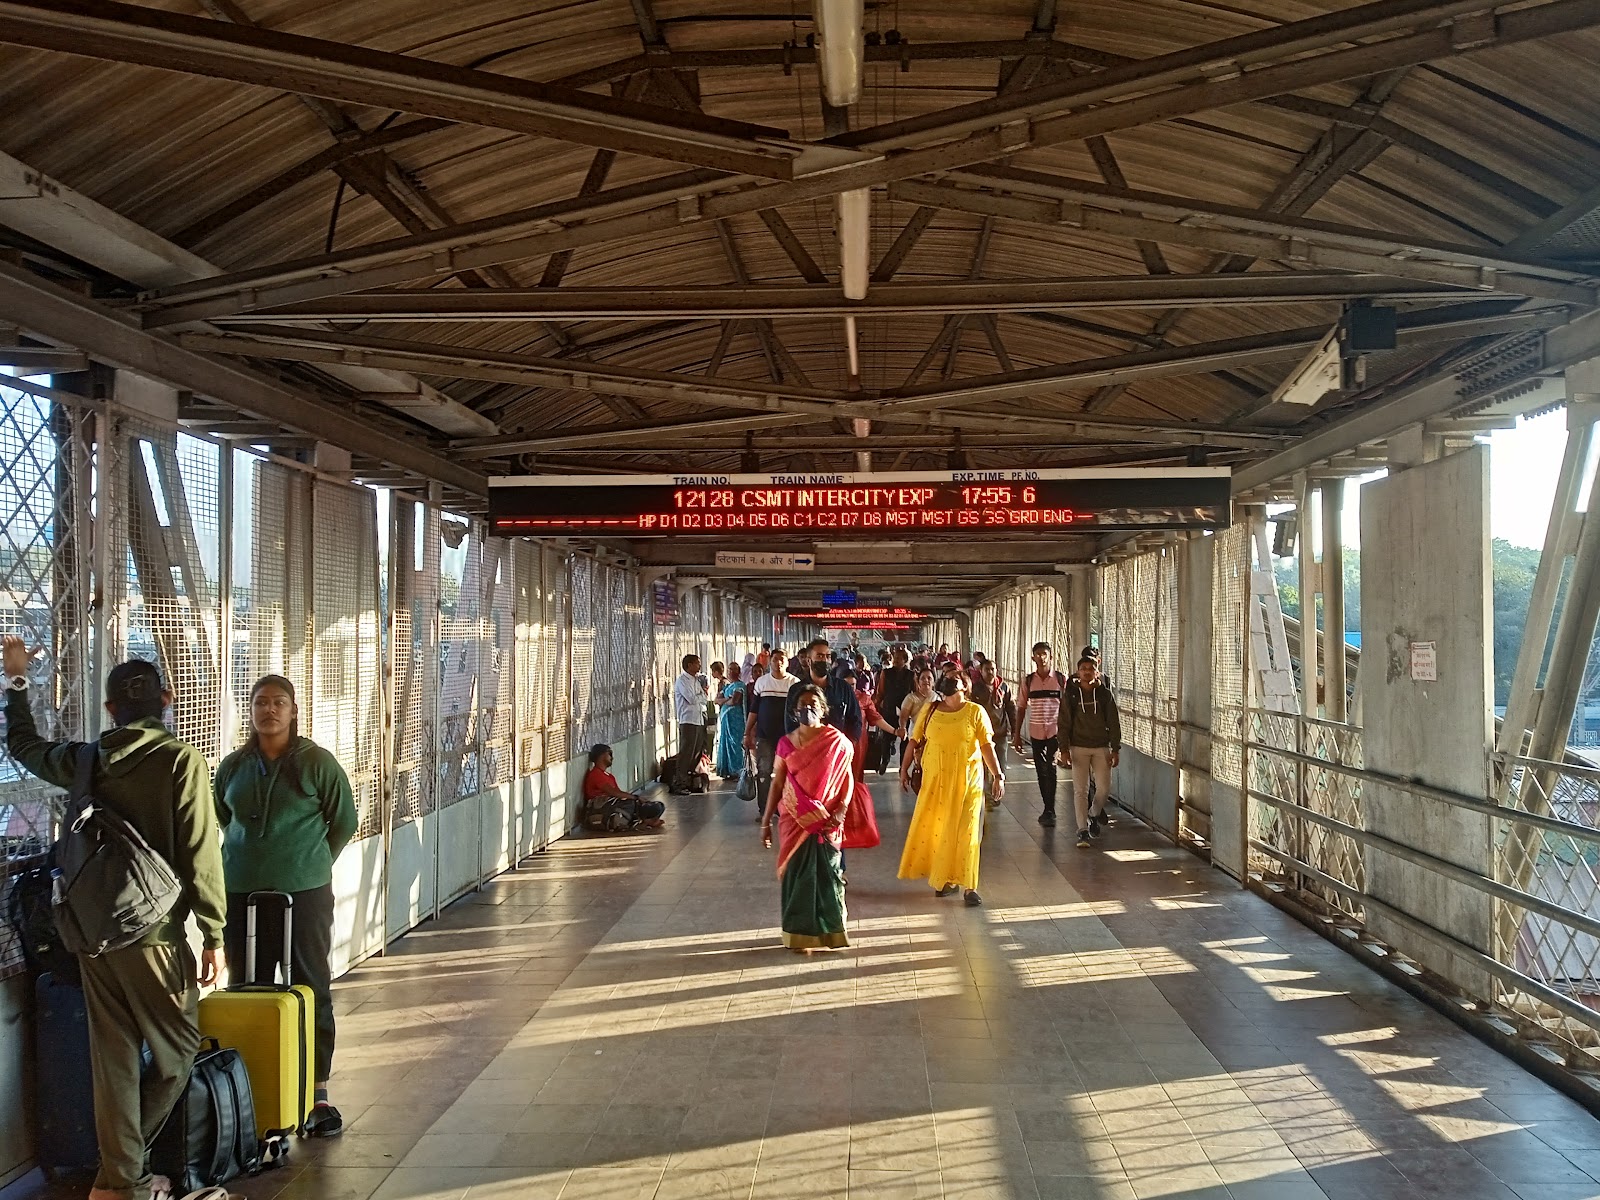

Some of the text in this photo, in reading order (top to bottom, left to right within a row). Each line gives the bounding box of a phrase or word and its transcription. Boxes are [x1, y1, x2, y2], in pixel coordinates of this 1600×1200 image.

[673, 476, 731, 485] TRAIN NO.
[770, 475, 843, 484] TRAIN NAME
[674, 486, 1036, 508] 12128 CSMT INTERCITY EXP 17:55 6
[660, 514, 677, 528] D1
[683, 514, 700, 527] D2
[705, 514, 723, 527] D3
[727, 513, 745, 527] D4
[749, 513, 767, 527] D5
[771, 513, 789, 527] D6
[793, 512, 812, 526] C1
[817, 512, 837, 526] C2
[841, 512, 859, 526] D7
[886, 511, 918, 526] MST
[922, 511, 954, 525] MST
[958, 511, 980, 525] GS
[1043, 509, 1073, 524] ENG
[760, 557, 765, 565] 4
